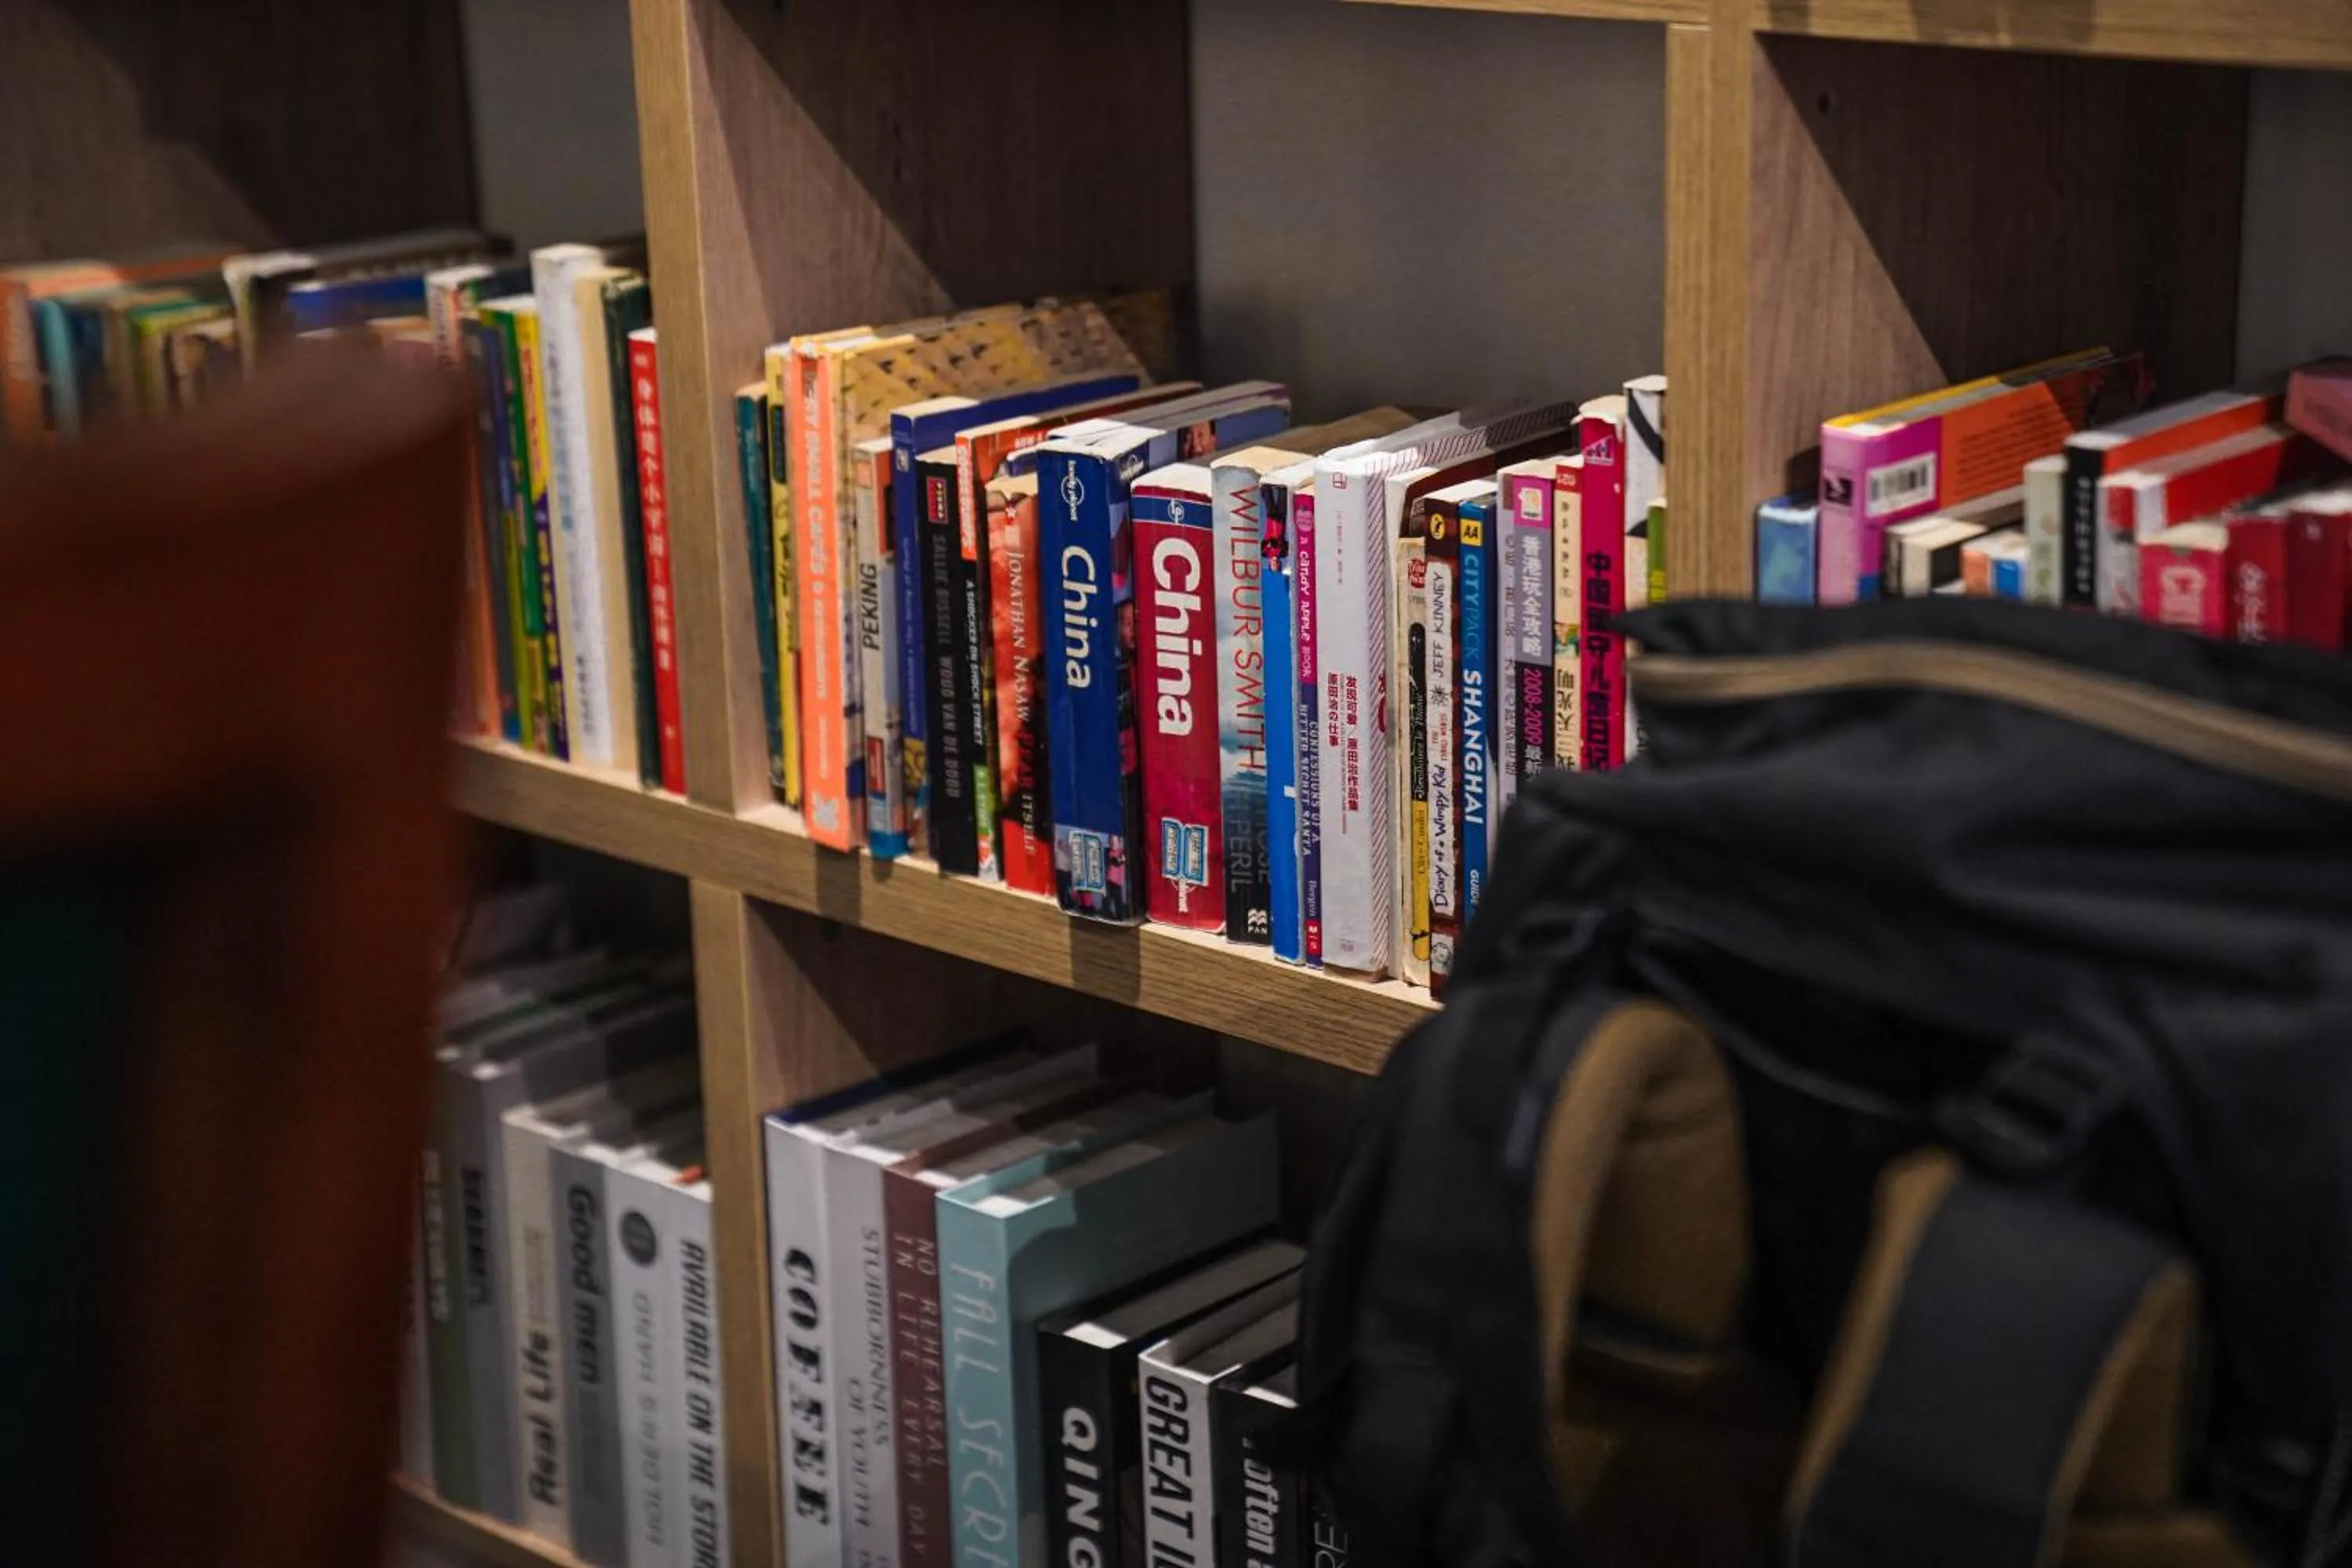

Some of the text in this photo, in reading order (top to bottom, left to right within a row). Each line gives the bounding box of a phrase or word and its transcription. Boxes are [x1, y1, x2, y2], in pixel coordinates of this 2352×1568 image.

[1067, 459, 1077, 522] lonely planet
[1461, 524, 1482, 542] AA
[863, 563, 880, 651] PEKING
[1007, 552, 1026, 648] JONATHAN
[1059, 545, 1098, 689] China
[1152, 538, 1203, 737] China
[1229, 485, 1265, 770] WILBUR SMITH
[1432, 570, 1446, 678] JEFF KINNEY
[941, 702, 956, 731] VAN
[970, 662, 980, 701] SHOCK
[971, 702, 982, 746] STREET
[1014, 655, 1031, 723] NASAW
[1463, 553, 1484, 826] CITYPACK SHANGHAI
[1523, 667, 1544, 746] 2008-2009
[1432, 761, 1446, 789] Kid
[1432, 790, 1449, 837] Wimpy
[1022, 793, 1035, 855] ITSELF
[1229, 820, 1253, 894] PERIL
[1307, 879, 1318, 917] Bergen
[1432, 864, 1450, 908] Diary
[568, 1183, 607, 1298] Good
[680, 1240, 712, 1387] AVAILABLE
[861, 1226, 891, 1447] STUBBORNNESS
[916, 1238, 946, 1468] NO REHEARSAL
[949, 1263, 1001, 1373] FALL
[521, 1330, 554, 1403] Life
[783, 1247, 831, 1527] COFFEE
[892, 1232, 928, 1555] IN LIFE EVERY DAY
[685, 1392, 714, 1436] ON
[848, 1376, 872, 1528] OF YOUTH
[1145, 1375, 1195, 1541] GREAT
[524, 1414, 560, 1507] Real
[688, 1441, 717, 1491] THE
[1243, 1457, 1279, 1555] often
